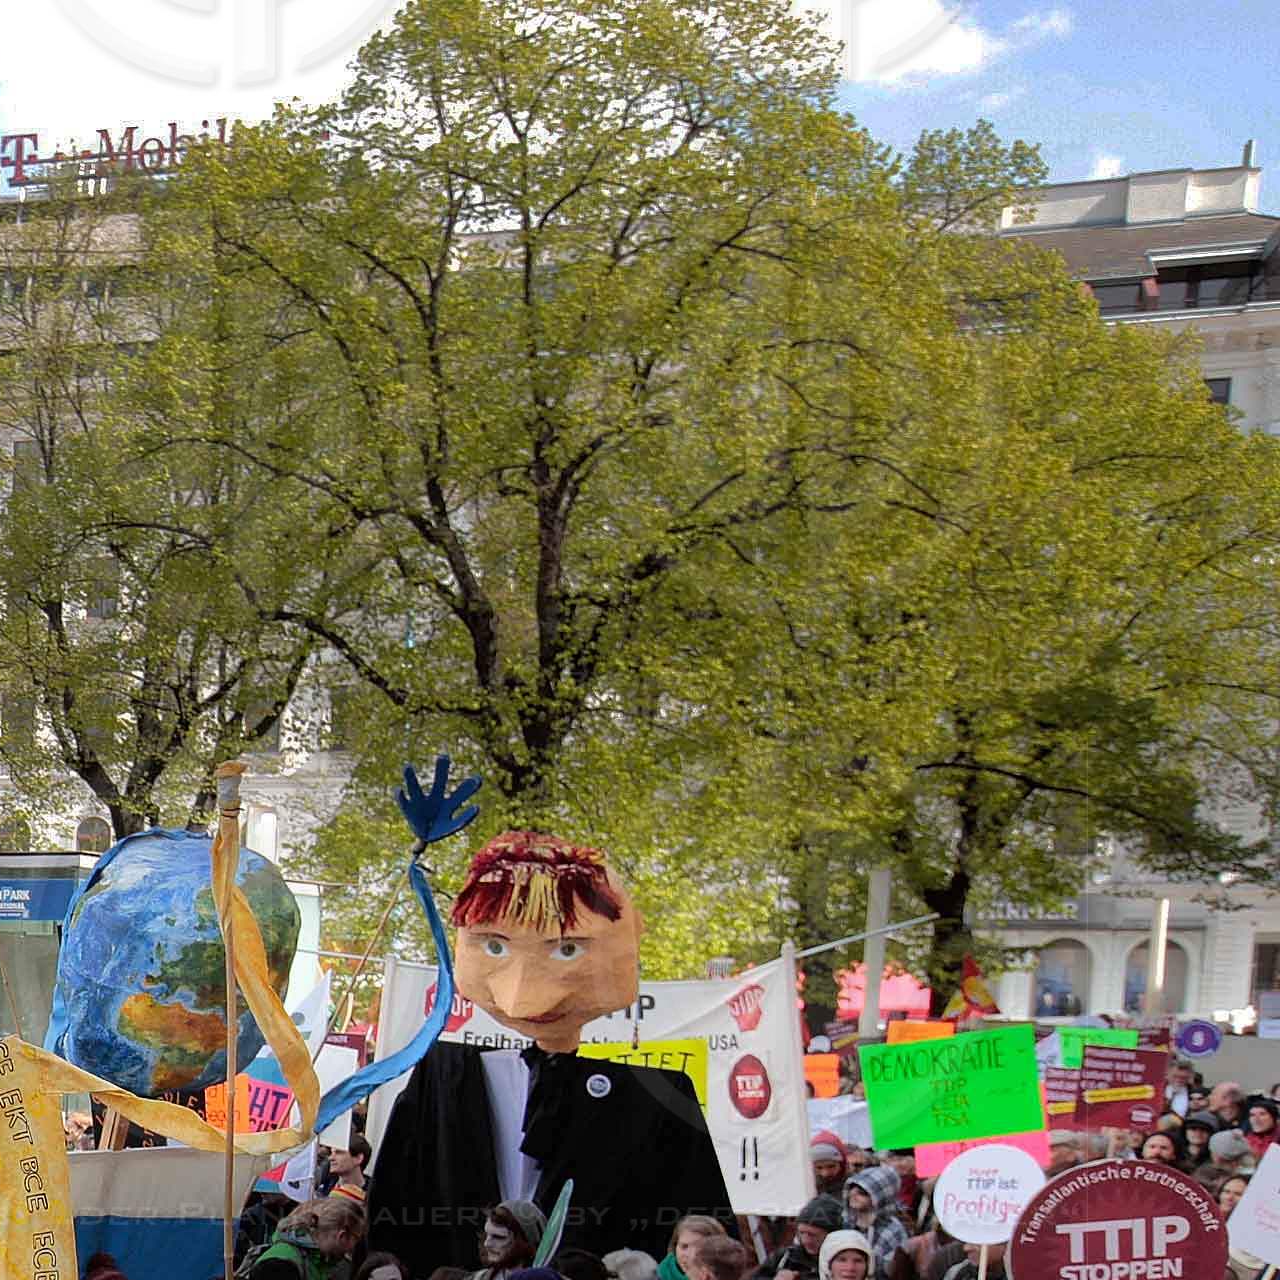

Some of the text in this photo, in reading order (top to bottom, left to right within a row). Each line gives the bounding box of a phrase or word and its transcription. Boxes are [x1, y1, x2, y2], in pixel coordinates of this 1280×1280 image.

[96, 118, 228, 170] Mobil
[708, 1035, 740, 1050] USA
[869, 1036, 1007, 1083] DEMOKRATIE
[19, 1156, 49, 1214] BCE
[1020, 1167, 1131, 1245] Transatlantische
[1134, 1166, 1220, 1233] Partnerschaft
[1055, 1215, 1190, 1264] TTIP
